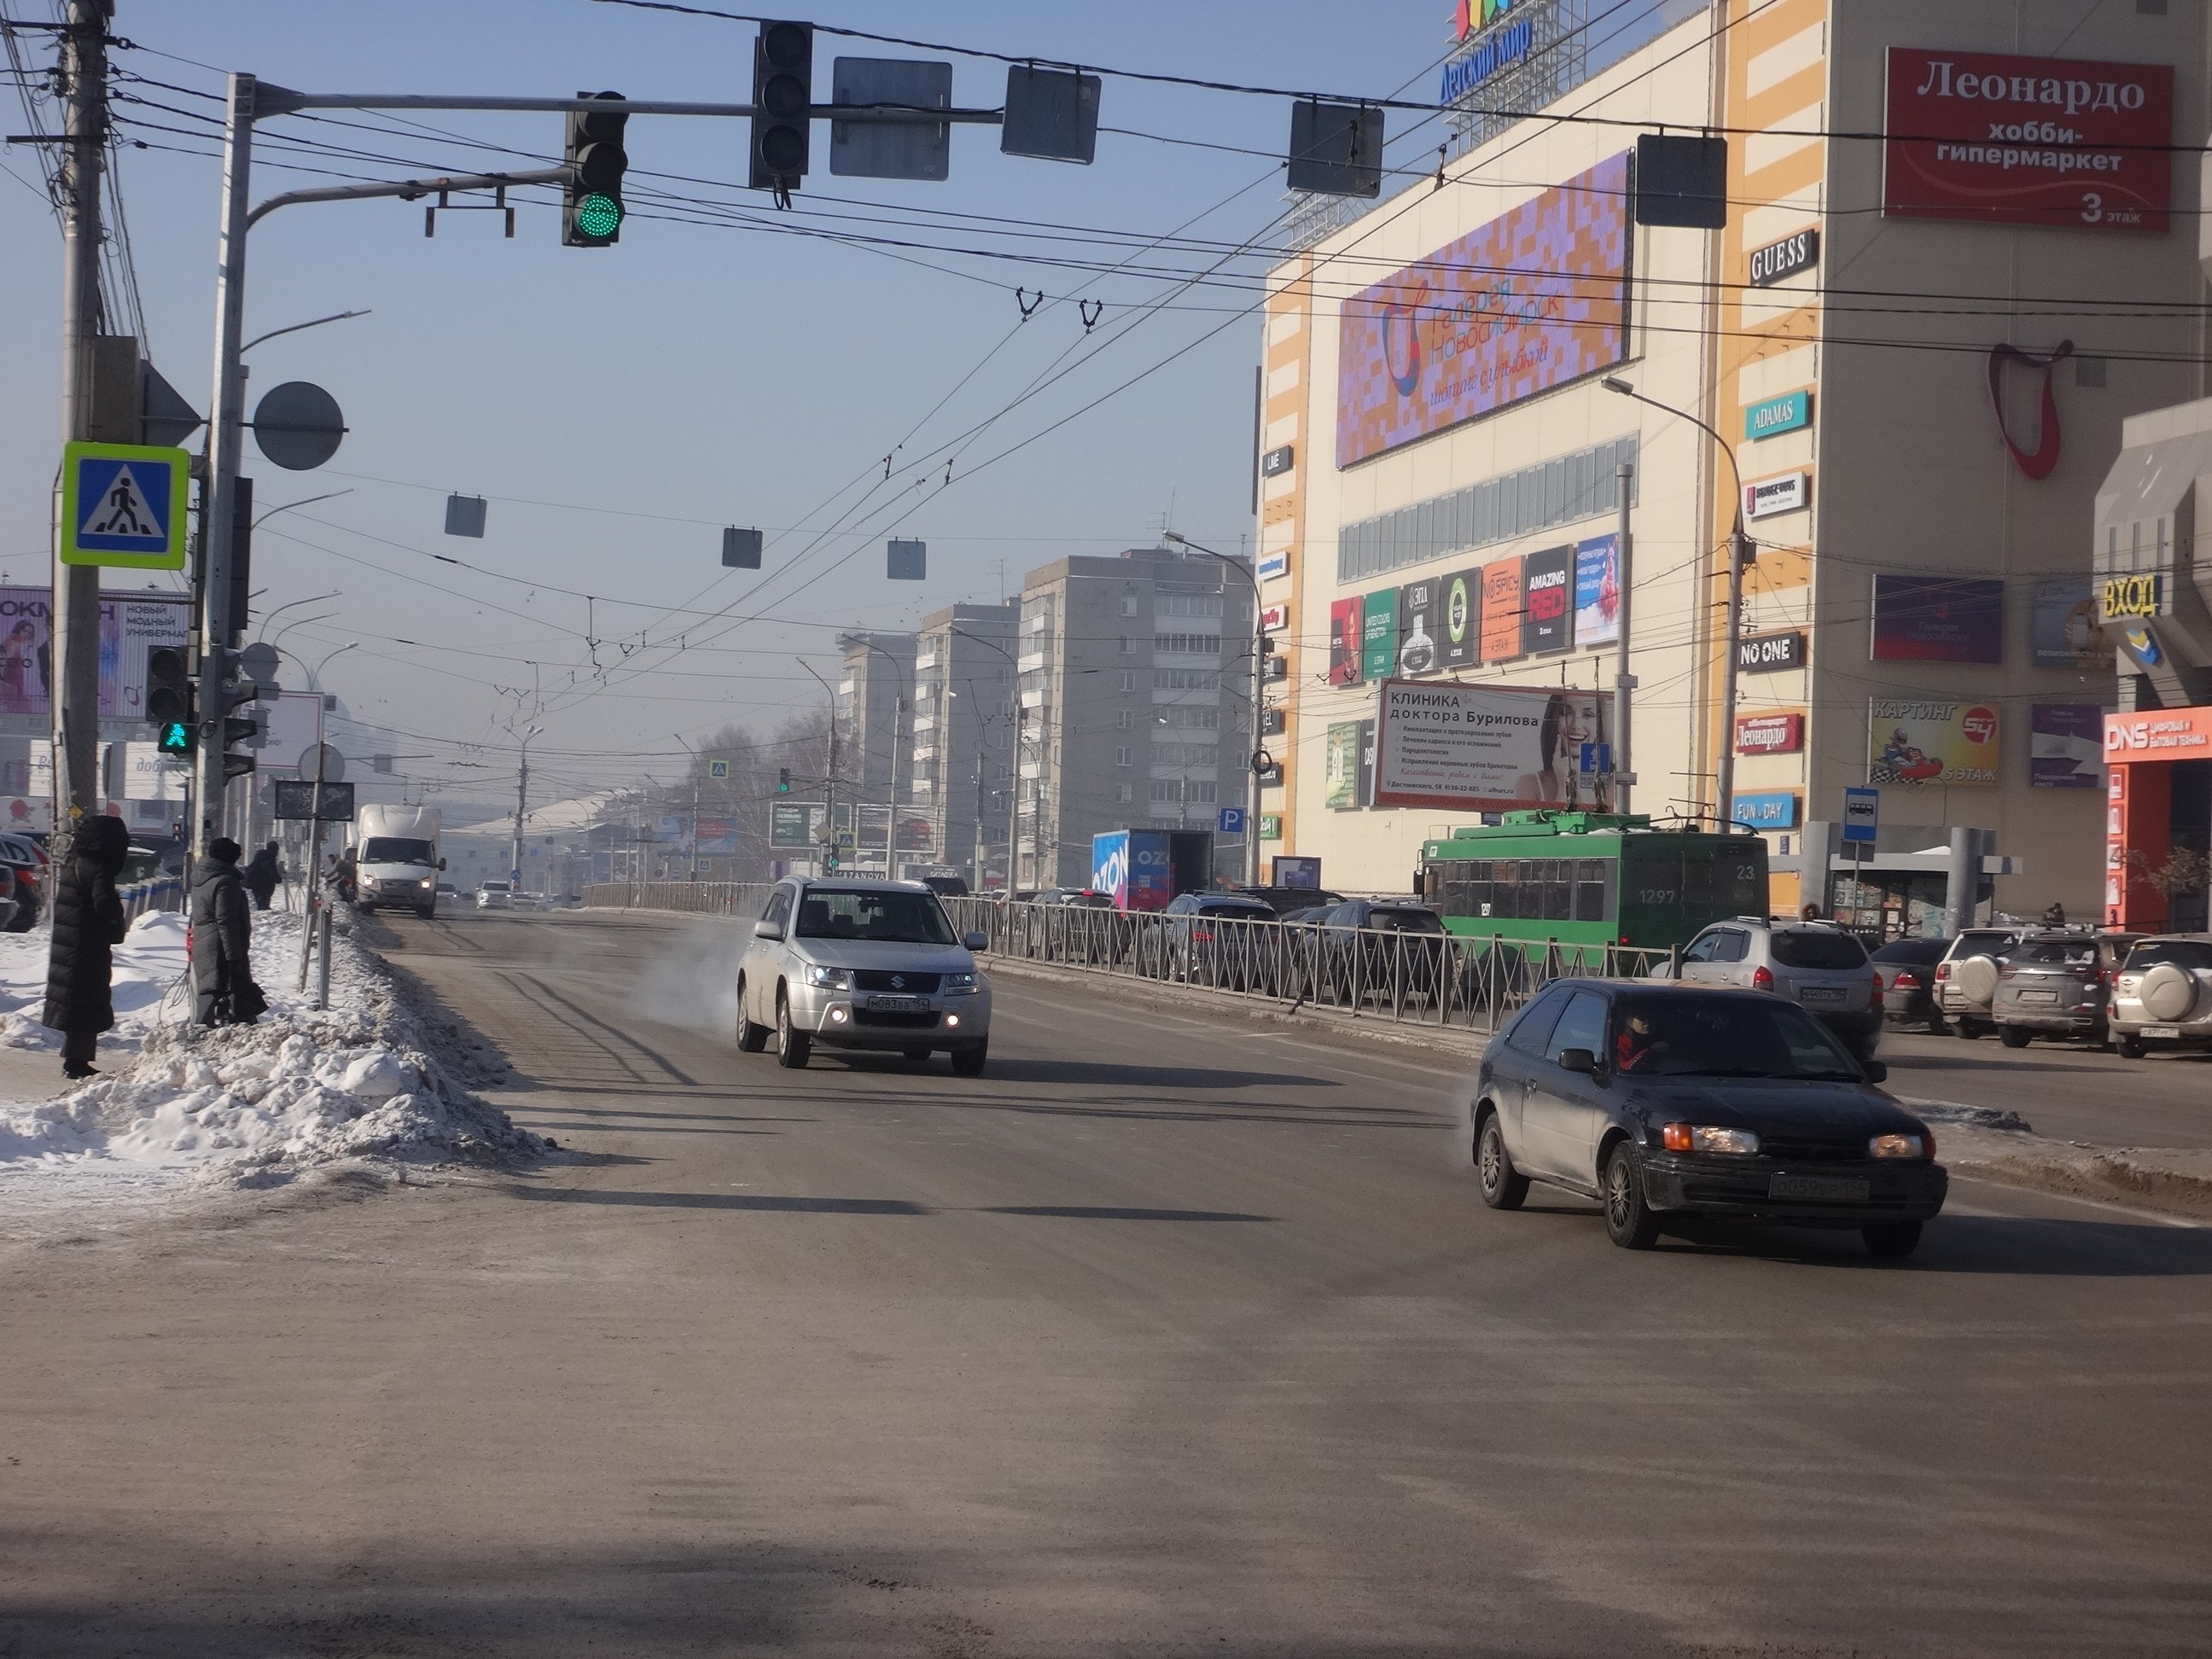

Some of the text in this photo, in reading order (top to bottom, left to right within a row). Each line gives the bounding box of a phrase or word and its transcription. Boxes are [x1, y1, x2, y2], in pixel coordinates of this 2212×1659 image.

[1440, 19, 1533, 106] Детский мир
[1917, 61, 2145, 114] Леонардо
[1988, 121, 2084, 144] хобби-
[1936, 146, 2122, 172] гипермаркет
[2081, 193, 2142, 224] 3 этаж
[1751, 233, 1806, 280] GUESS
[1431, 278, 1511, 334] Галерея
[1431, 290, 1559, 365] Новосибирск
[1429, 338, 1549, 406] шопинг с улыбкой
[1754, 401, 1793, 430] ADAMAS
[1529, 571, 1565, 591] AMAZING
[2103, 574, 2155, 618] ВХОД
[126, 604, 166, 614] НОВЫЙ
[126, 616, 176, 626] МОДНЫЙ
[126, 628, 189, 638] УНИВЕРМАГ
[1741, 638, 1791, 667] NO ONE
[1390, 691, 1460, 708] КЛИНИКА
[1390, 707, 1539, 726] доктора Бурилова
[1873, 702, 1957, 720] КАРТИНГ
[1403, 725, 1443, 735] Имплантация
[1447, 729, 1495, 738] протезирование
[1737, 725, 1785, 751] Леонардо
[2106, 723, 2149, 751] DNS
[1402, 747, 1449, 755] Пародонтология
[1401, 758, 1439, 766] Исправление
[1945, 767, 1997, 782] 5 ЭТАЖ
[1391, 781, 1434, 789] Достоевского,
[1738, 802, 1784, 821] FUN DAY
[1737, 865, 1755, 880] 23
[1639, 889, 1675, 904] 1297
